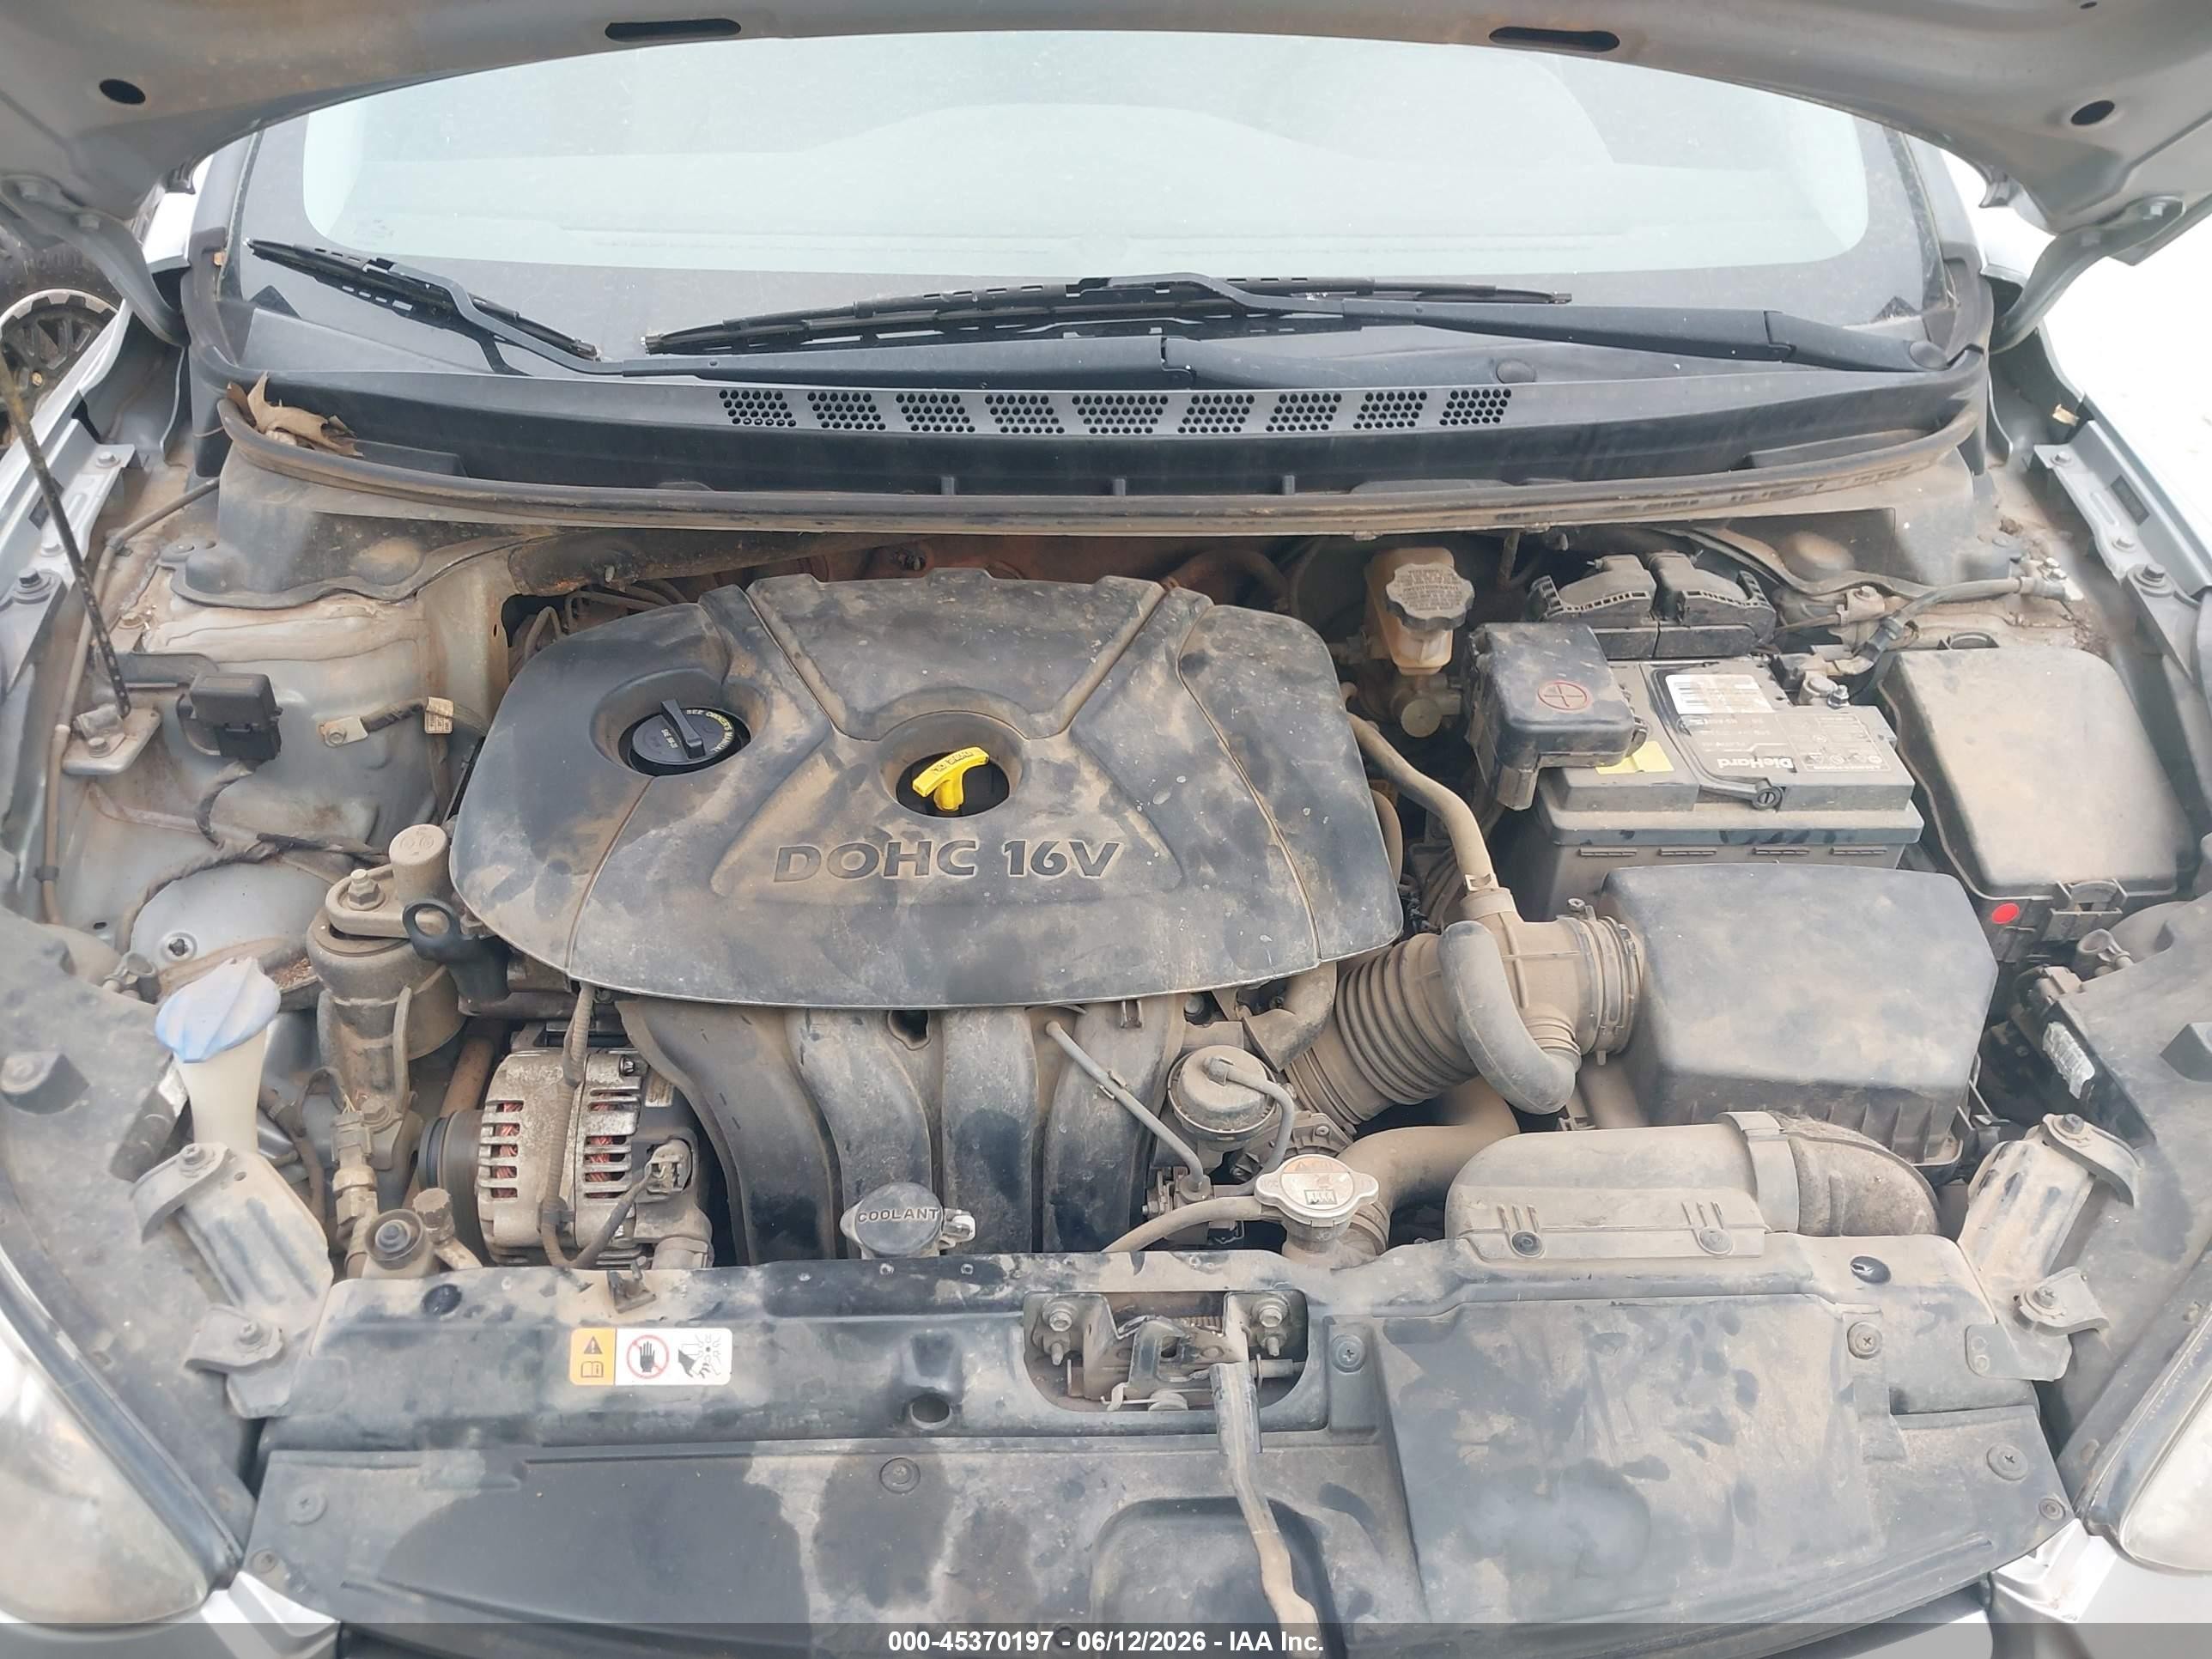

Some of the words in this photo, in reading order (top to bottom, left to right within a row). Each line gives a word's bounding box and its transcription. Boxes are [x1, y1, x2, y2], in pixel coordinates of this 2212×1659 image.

[710, 732, 734, 753] MANUAL
[1717, 757, 1795, 769] DieHard
[773, 839, 981, 884] DOHC
[1002, 839, 1120, 879] 16V
[857, 1207, 940, 1223] COOLANT
